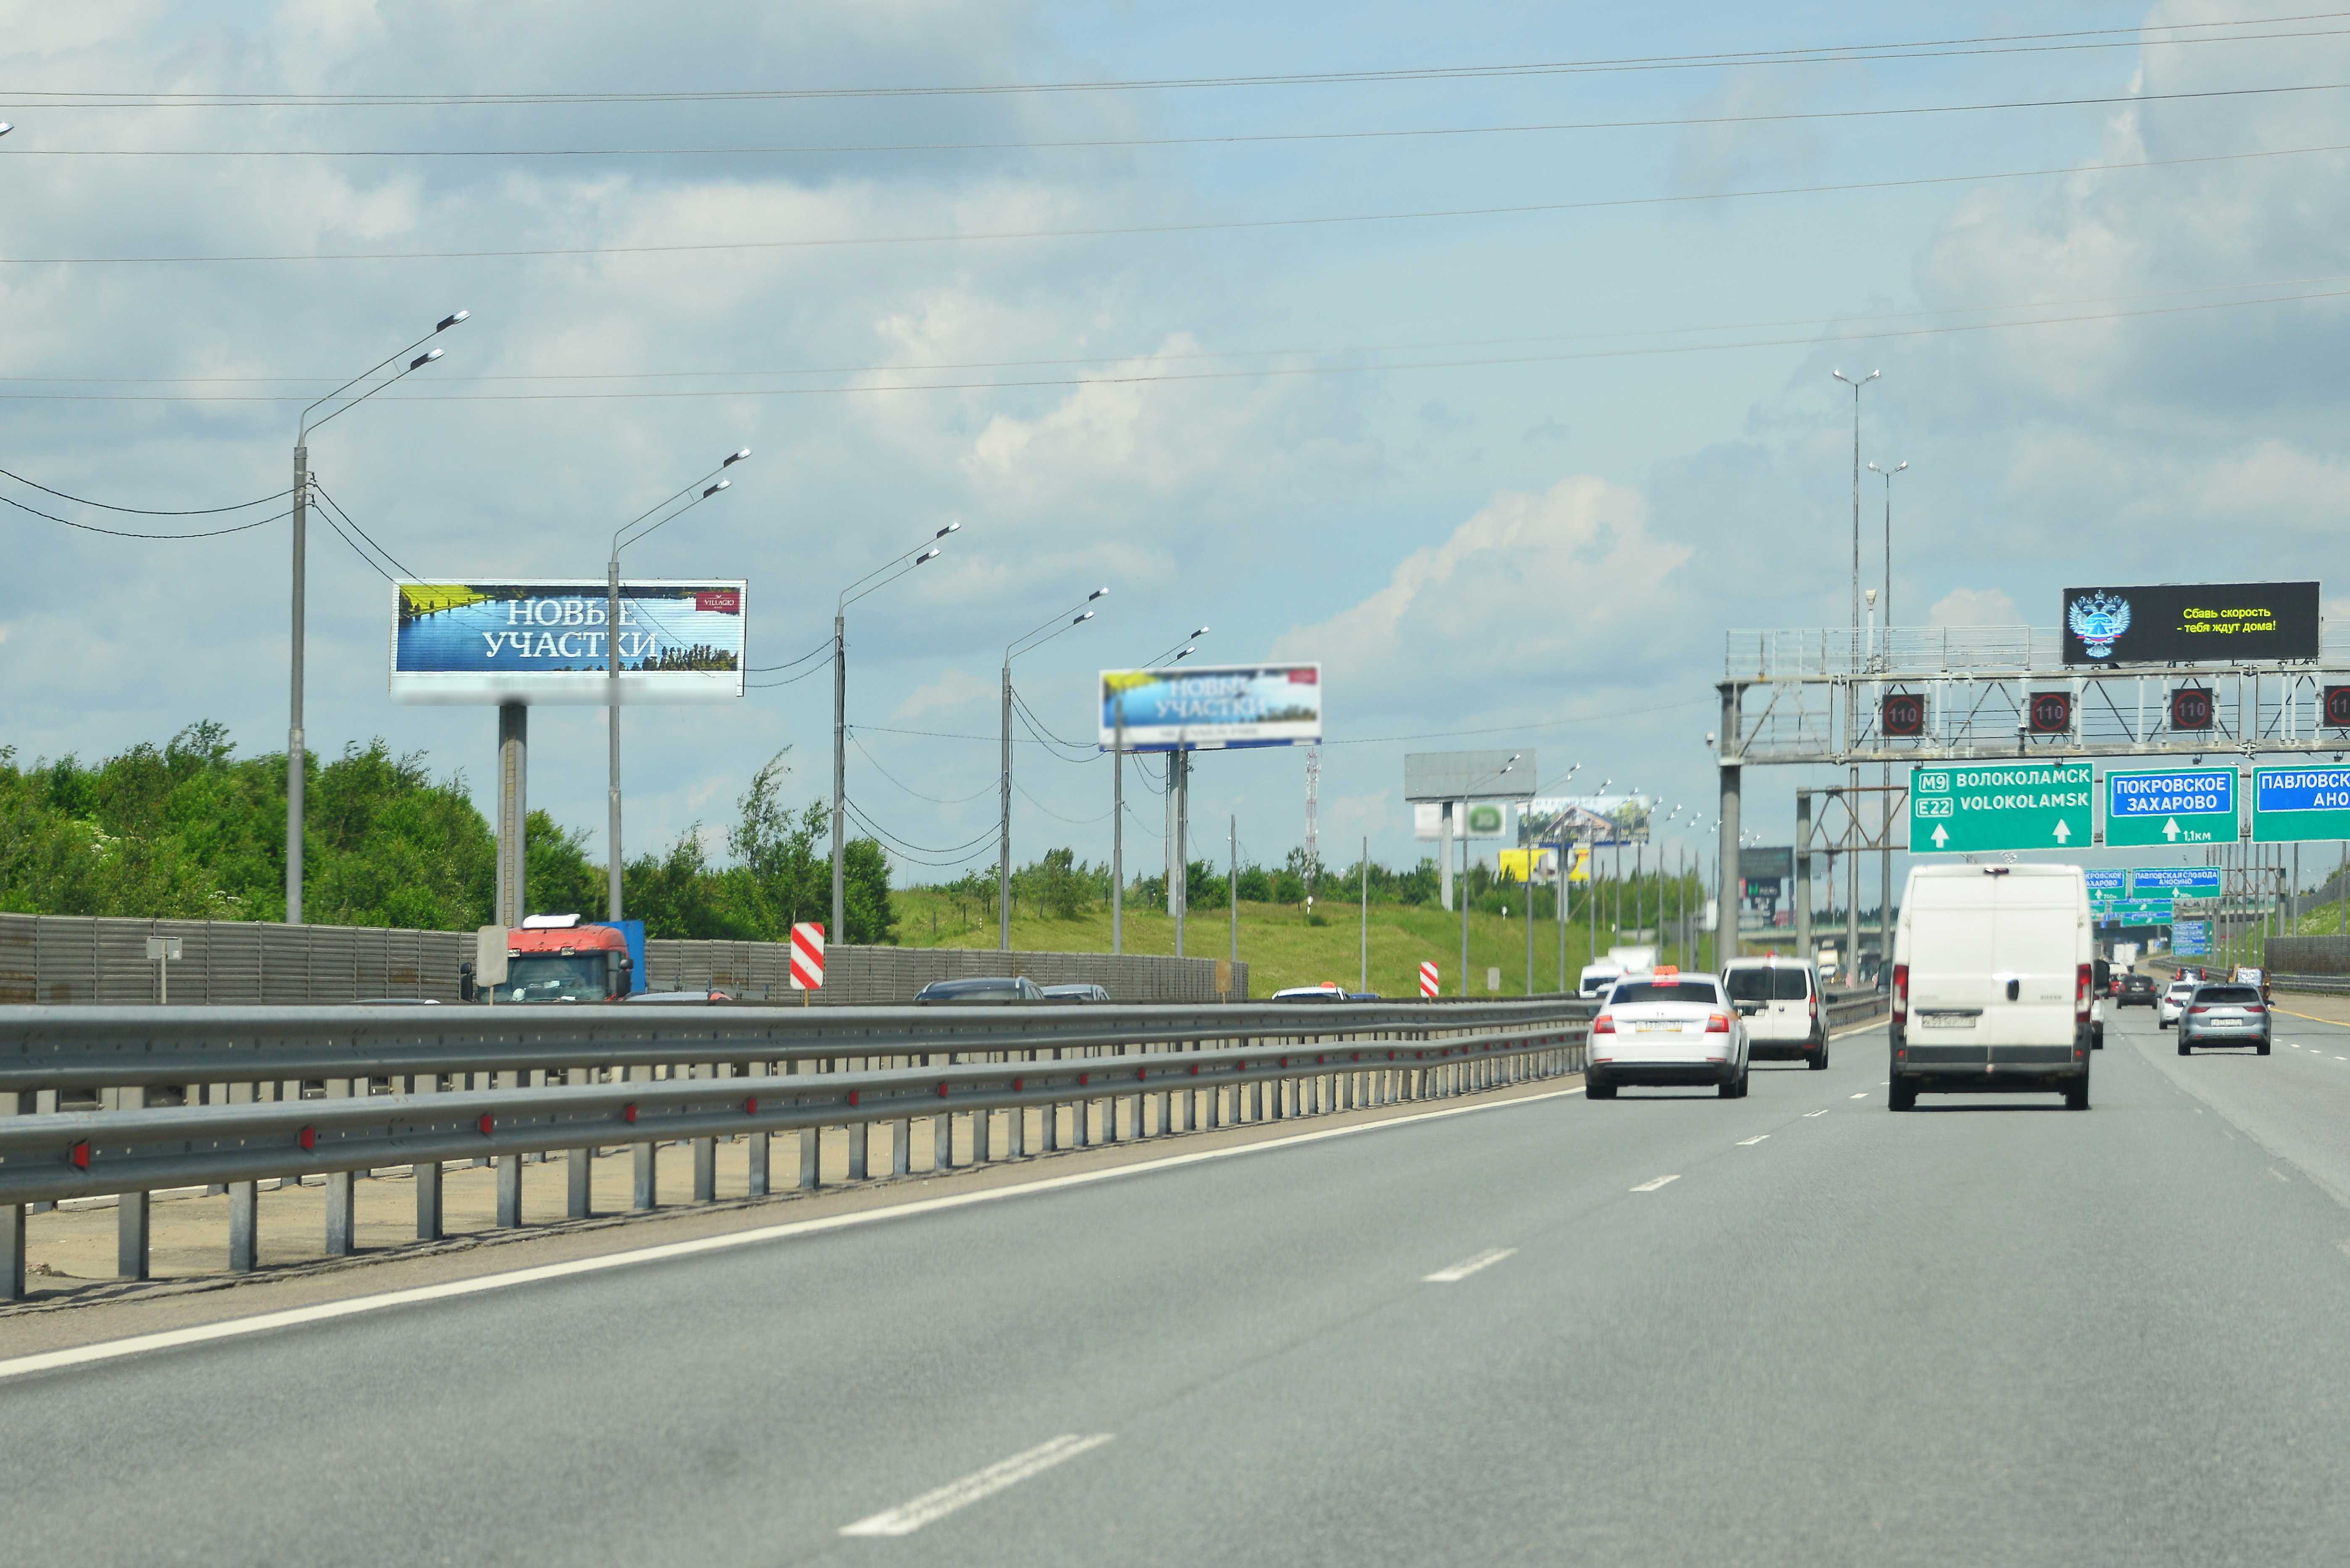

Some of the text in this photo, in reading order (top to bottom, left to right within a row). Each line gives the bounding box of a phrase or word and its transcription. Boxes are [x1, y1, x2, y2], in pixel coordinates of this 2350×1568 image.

[506, 599, 638, 626] НОВЫЕ
[2183, 608, 2271, 619] Сбавь скорость
[2184, 622, 2210, 633] тебя
[2212, 623, 2241, 634] ждут
[2242, 620, 2277, 633] дома!
[482, 631, 659, 658] УЧАСТКИ
[1889, 707, 1917, 723] 110
[2036, 705, 2064, 720] 110
[2179, 702, 2206, 717] 110
[1956, 769, 2090, 787] ВОЛОКОЛАМСК
[2116, 777, 2226, 794] ПОКРОВСКОЕ
[1919, 800, 1950, 815] E22
[1960, 792, 2089, 810] VOLOKOLAMSK
[2126, 795, 2218, 812] ЗАХАРОВО
